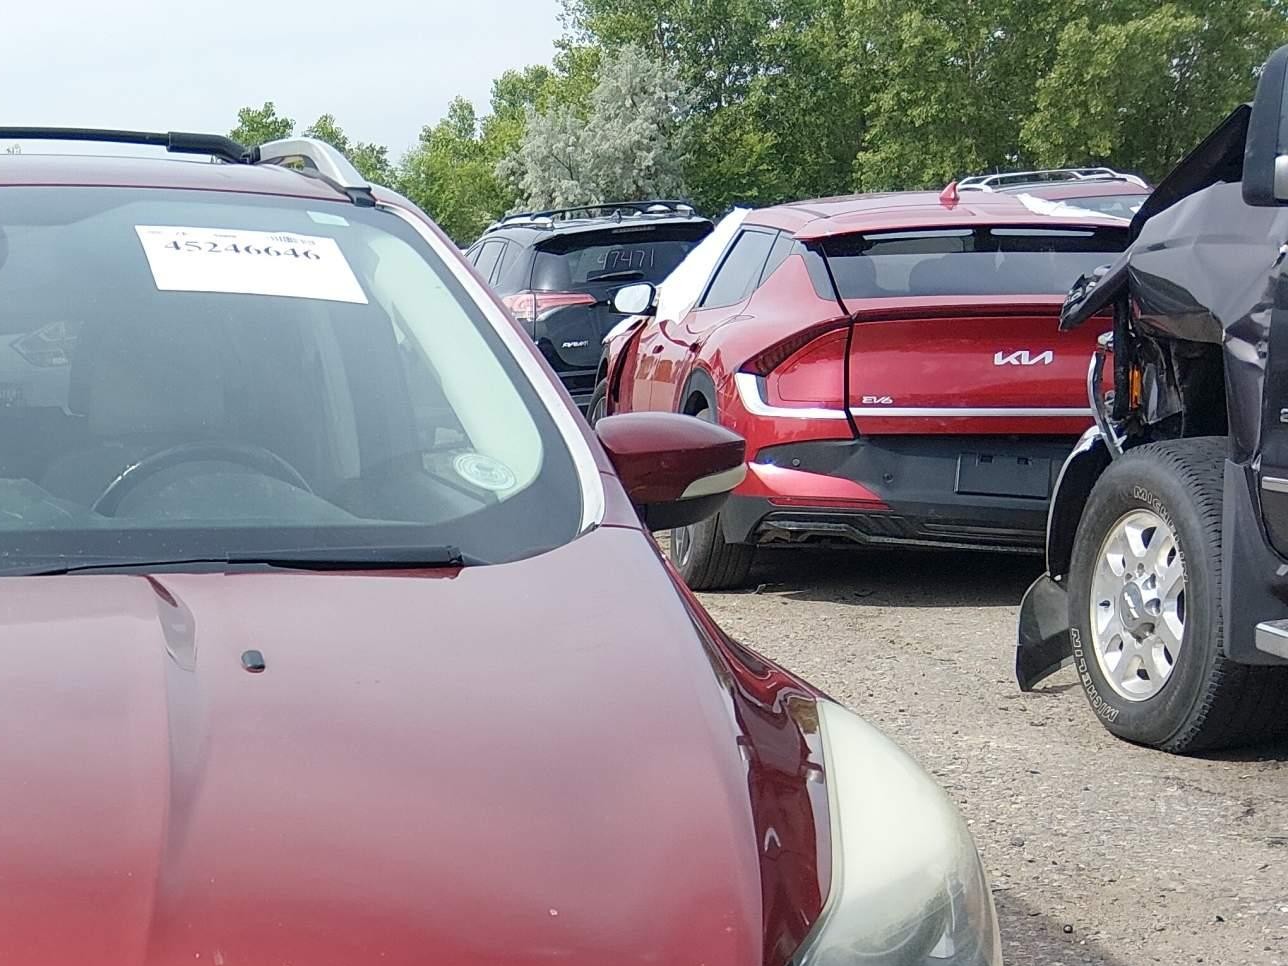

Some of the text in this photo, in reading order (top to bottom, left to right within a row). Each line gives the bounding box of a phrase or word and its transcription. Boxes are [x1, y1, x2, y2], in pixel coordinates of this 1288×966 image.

[164, 240, 321, 260] 45246646
[597, 248, 654, 270] 47471
[993, 350, 1054, 366] KIA
[862, 396, 893, 404] EV6
